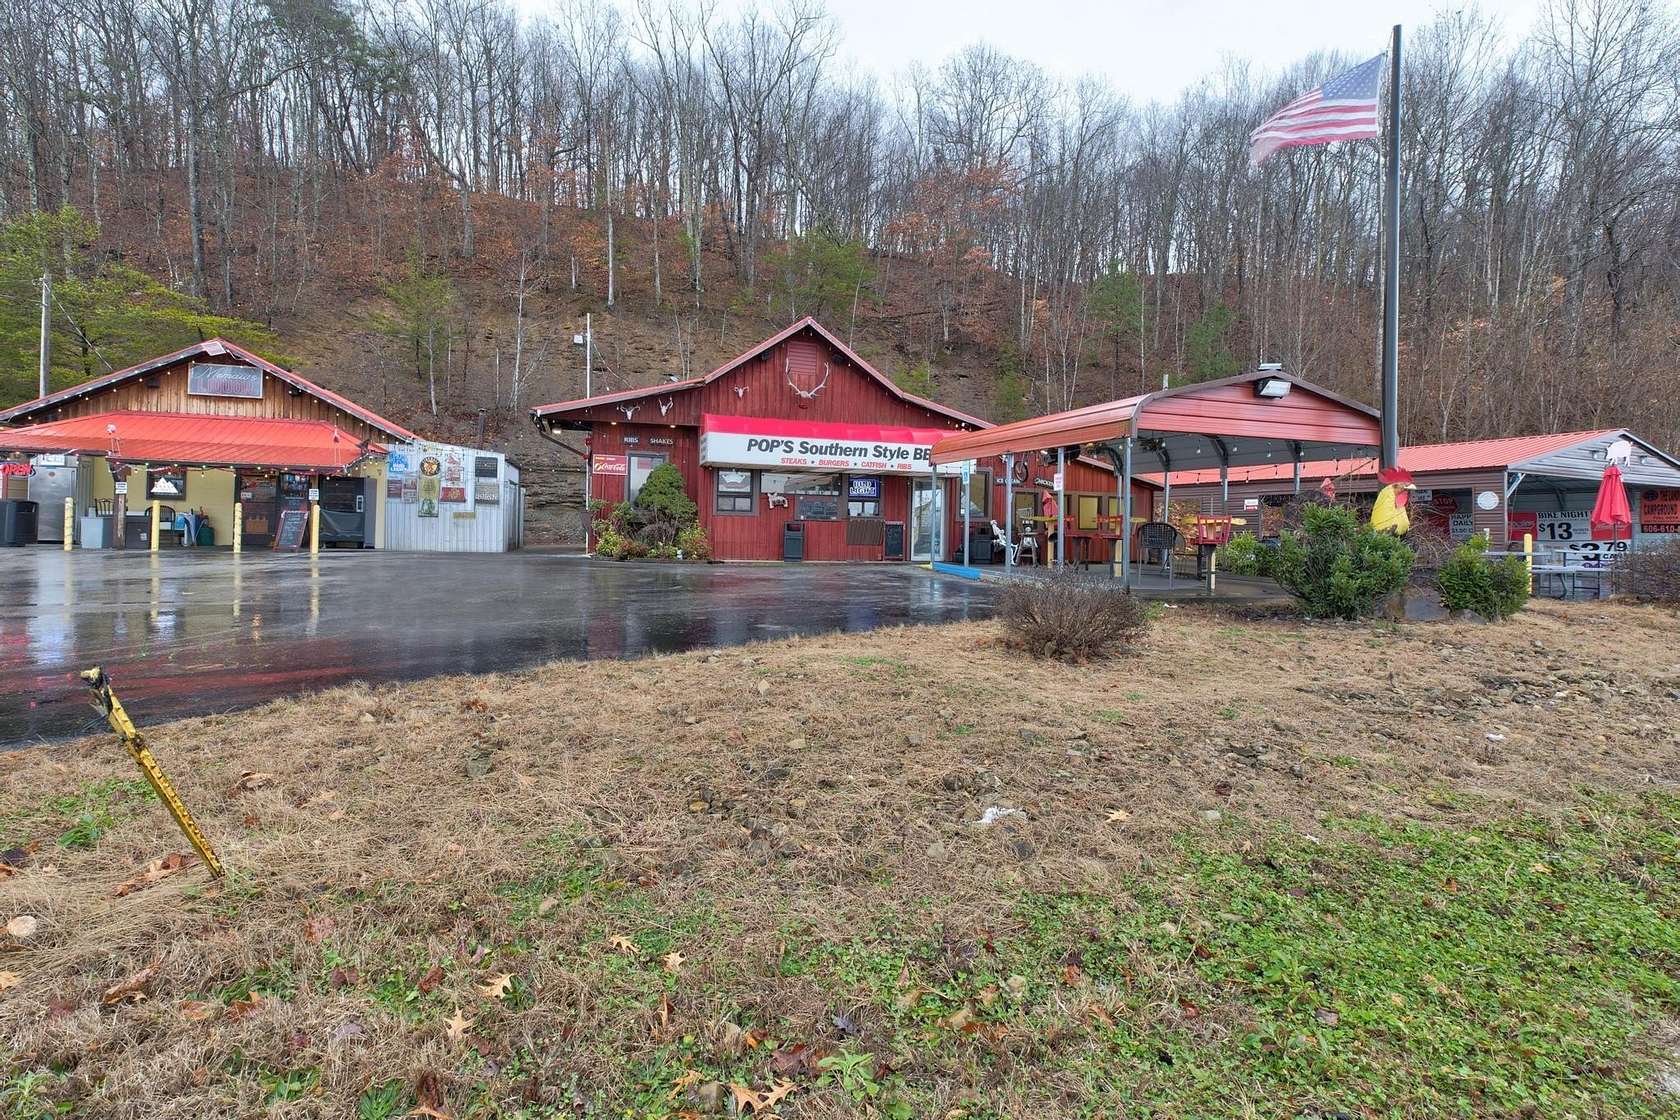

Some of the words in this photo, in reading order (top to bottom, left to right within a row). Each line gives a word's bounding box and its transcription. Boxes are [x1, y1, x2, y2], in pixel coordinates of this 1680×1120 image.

[747, 438, 794, 454] POP'S
[798, 441, 868, 458] Southern
[872, 445, 909, 461] Style
[913, 447, 932, 461] BB
[781, 457, 807, 465] STEAKS
[818, 459, 849, 467] BURGERS
[861, 461, 887, 469] CATFISH
[1560, 511, 1588, 519] NIGHT
[1643, 524, 1680, 533] 606-610-
